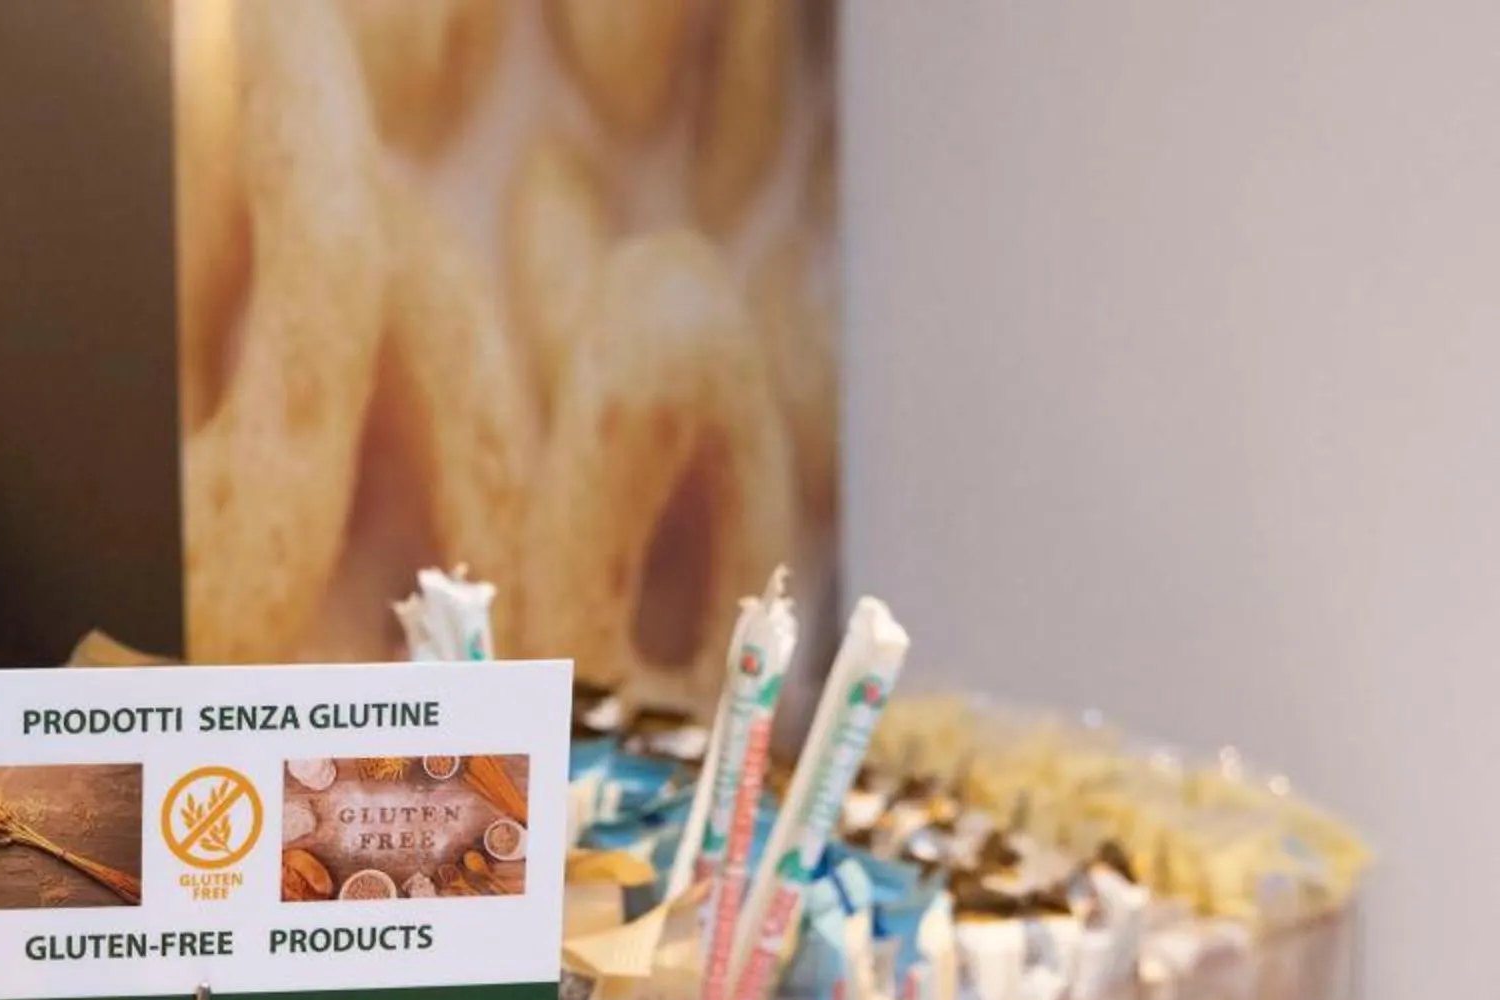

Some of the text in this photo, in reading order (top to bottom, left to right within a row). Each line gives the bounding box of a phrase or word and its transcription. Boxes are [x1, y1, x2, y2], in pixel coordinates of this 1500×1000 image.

[22, 701, 440, 735] PRODOTTI SENZA GLUTINE
[338, 804, 462, 825] GLUTEN
[358, 831, 437, 850] FREE
[179, 872, 244, 888] GLUTEN
[192, 886, 231, 901] FREE
[24, 924, 434, 961] GLUTEN-FREE PRODUCTS
